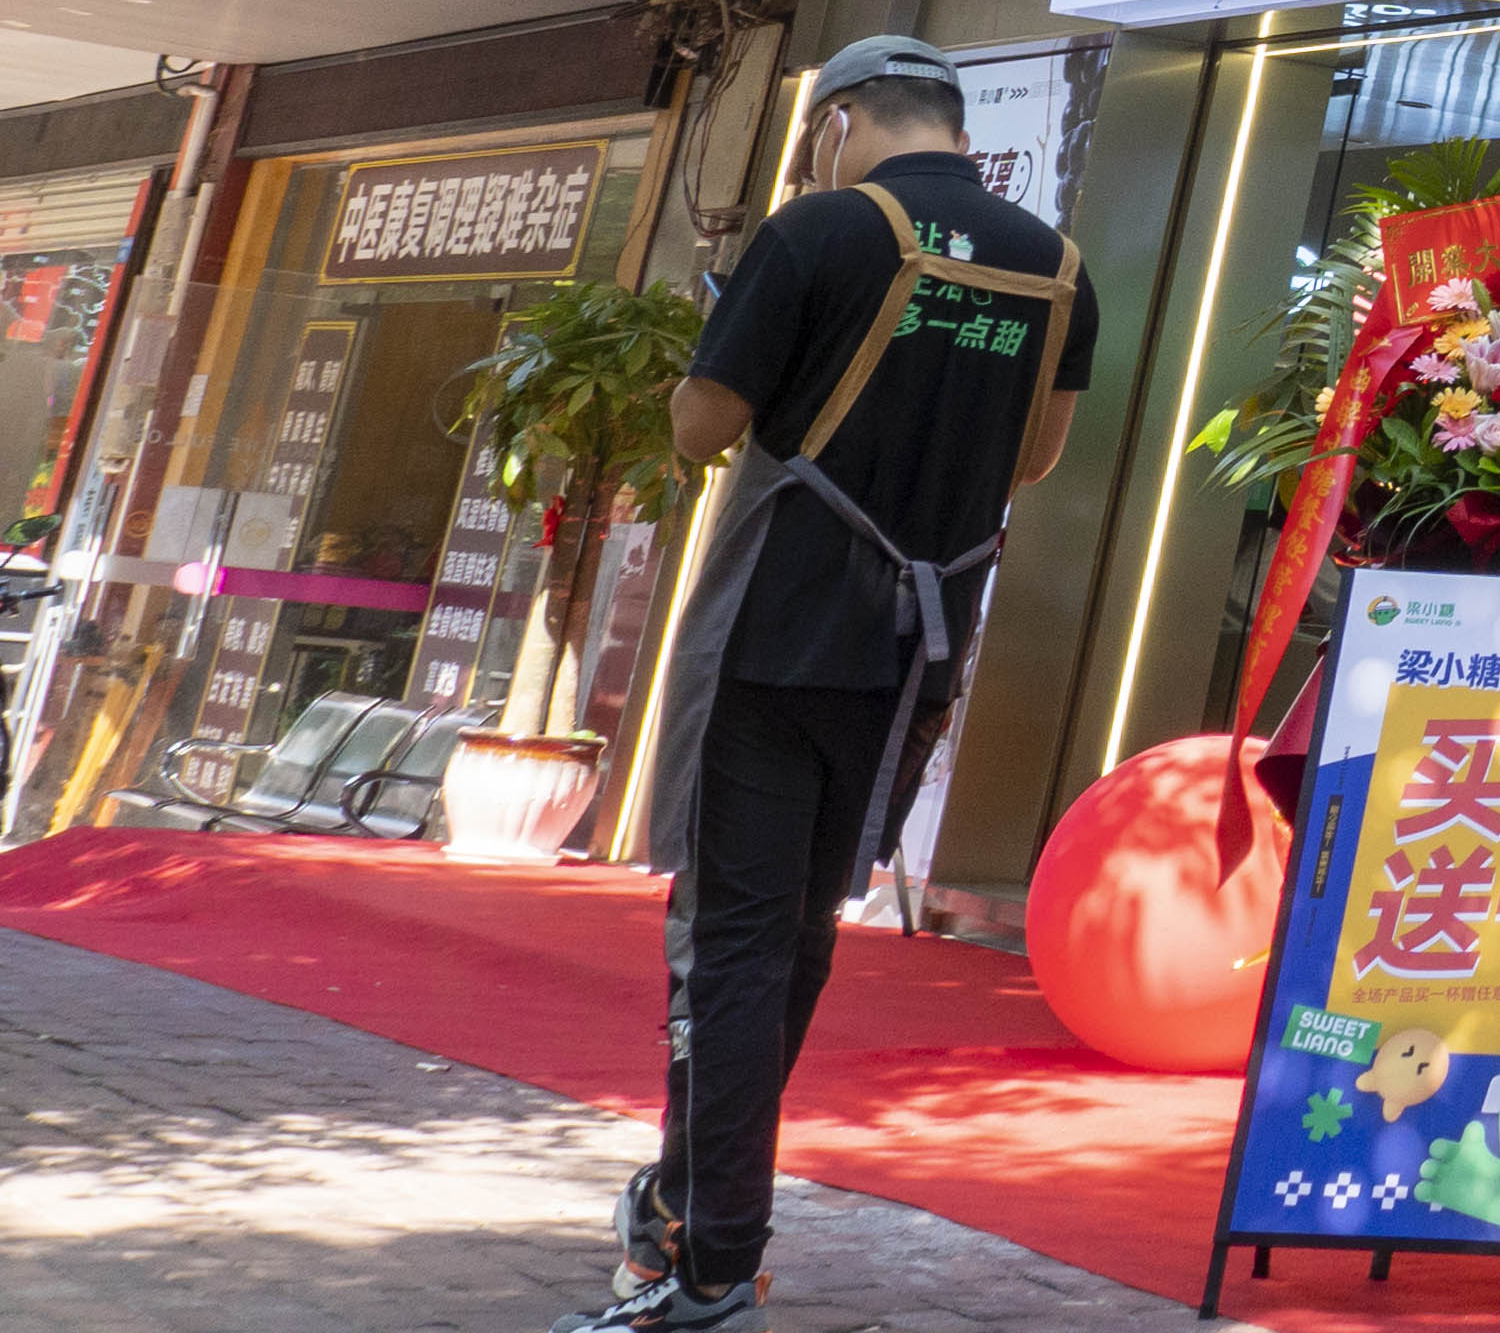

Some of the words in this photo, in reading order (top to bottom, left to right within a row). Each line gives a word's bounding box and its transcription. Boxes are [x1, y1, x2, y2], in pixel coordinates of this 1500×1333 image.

[337, 165, 590, 264] 中医康复调理疑难杂症
[892, 302, 1029, 357] 多一点甜
[1406, 600, 1455, 618] 梁小糖
[1299, 1010, 1371, 1041] SWEET
[1292, 1032, 1355, 1058] LIANG
